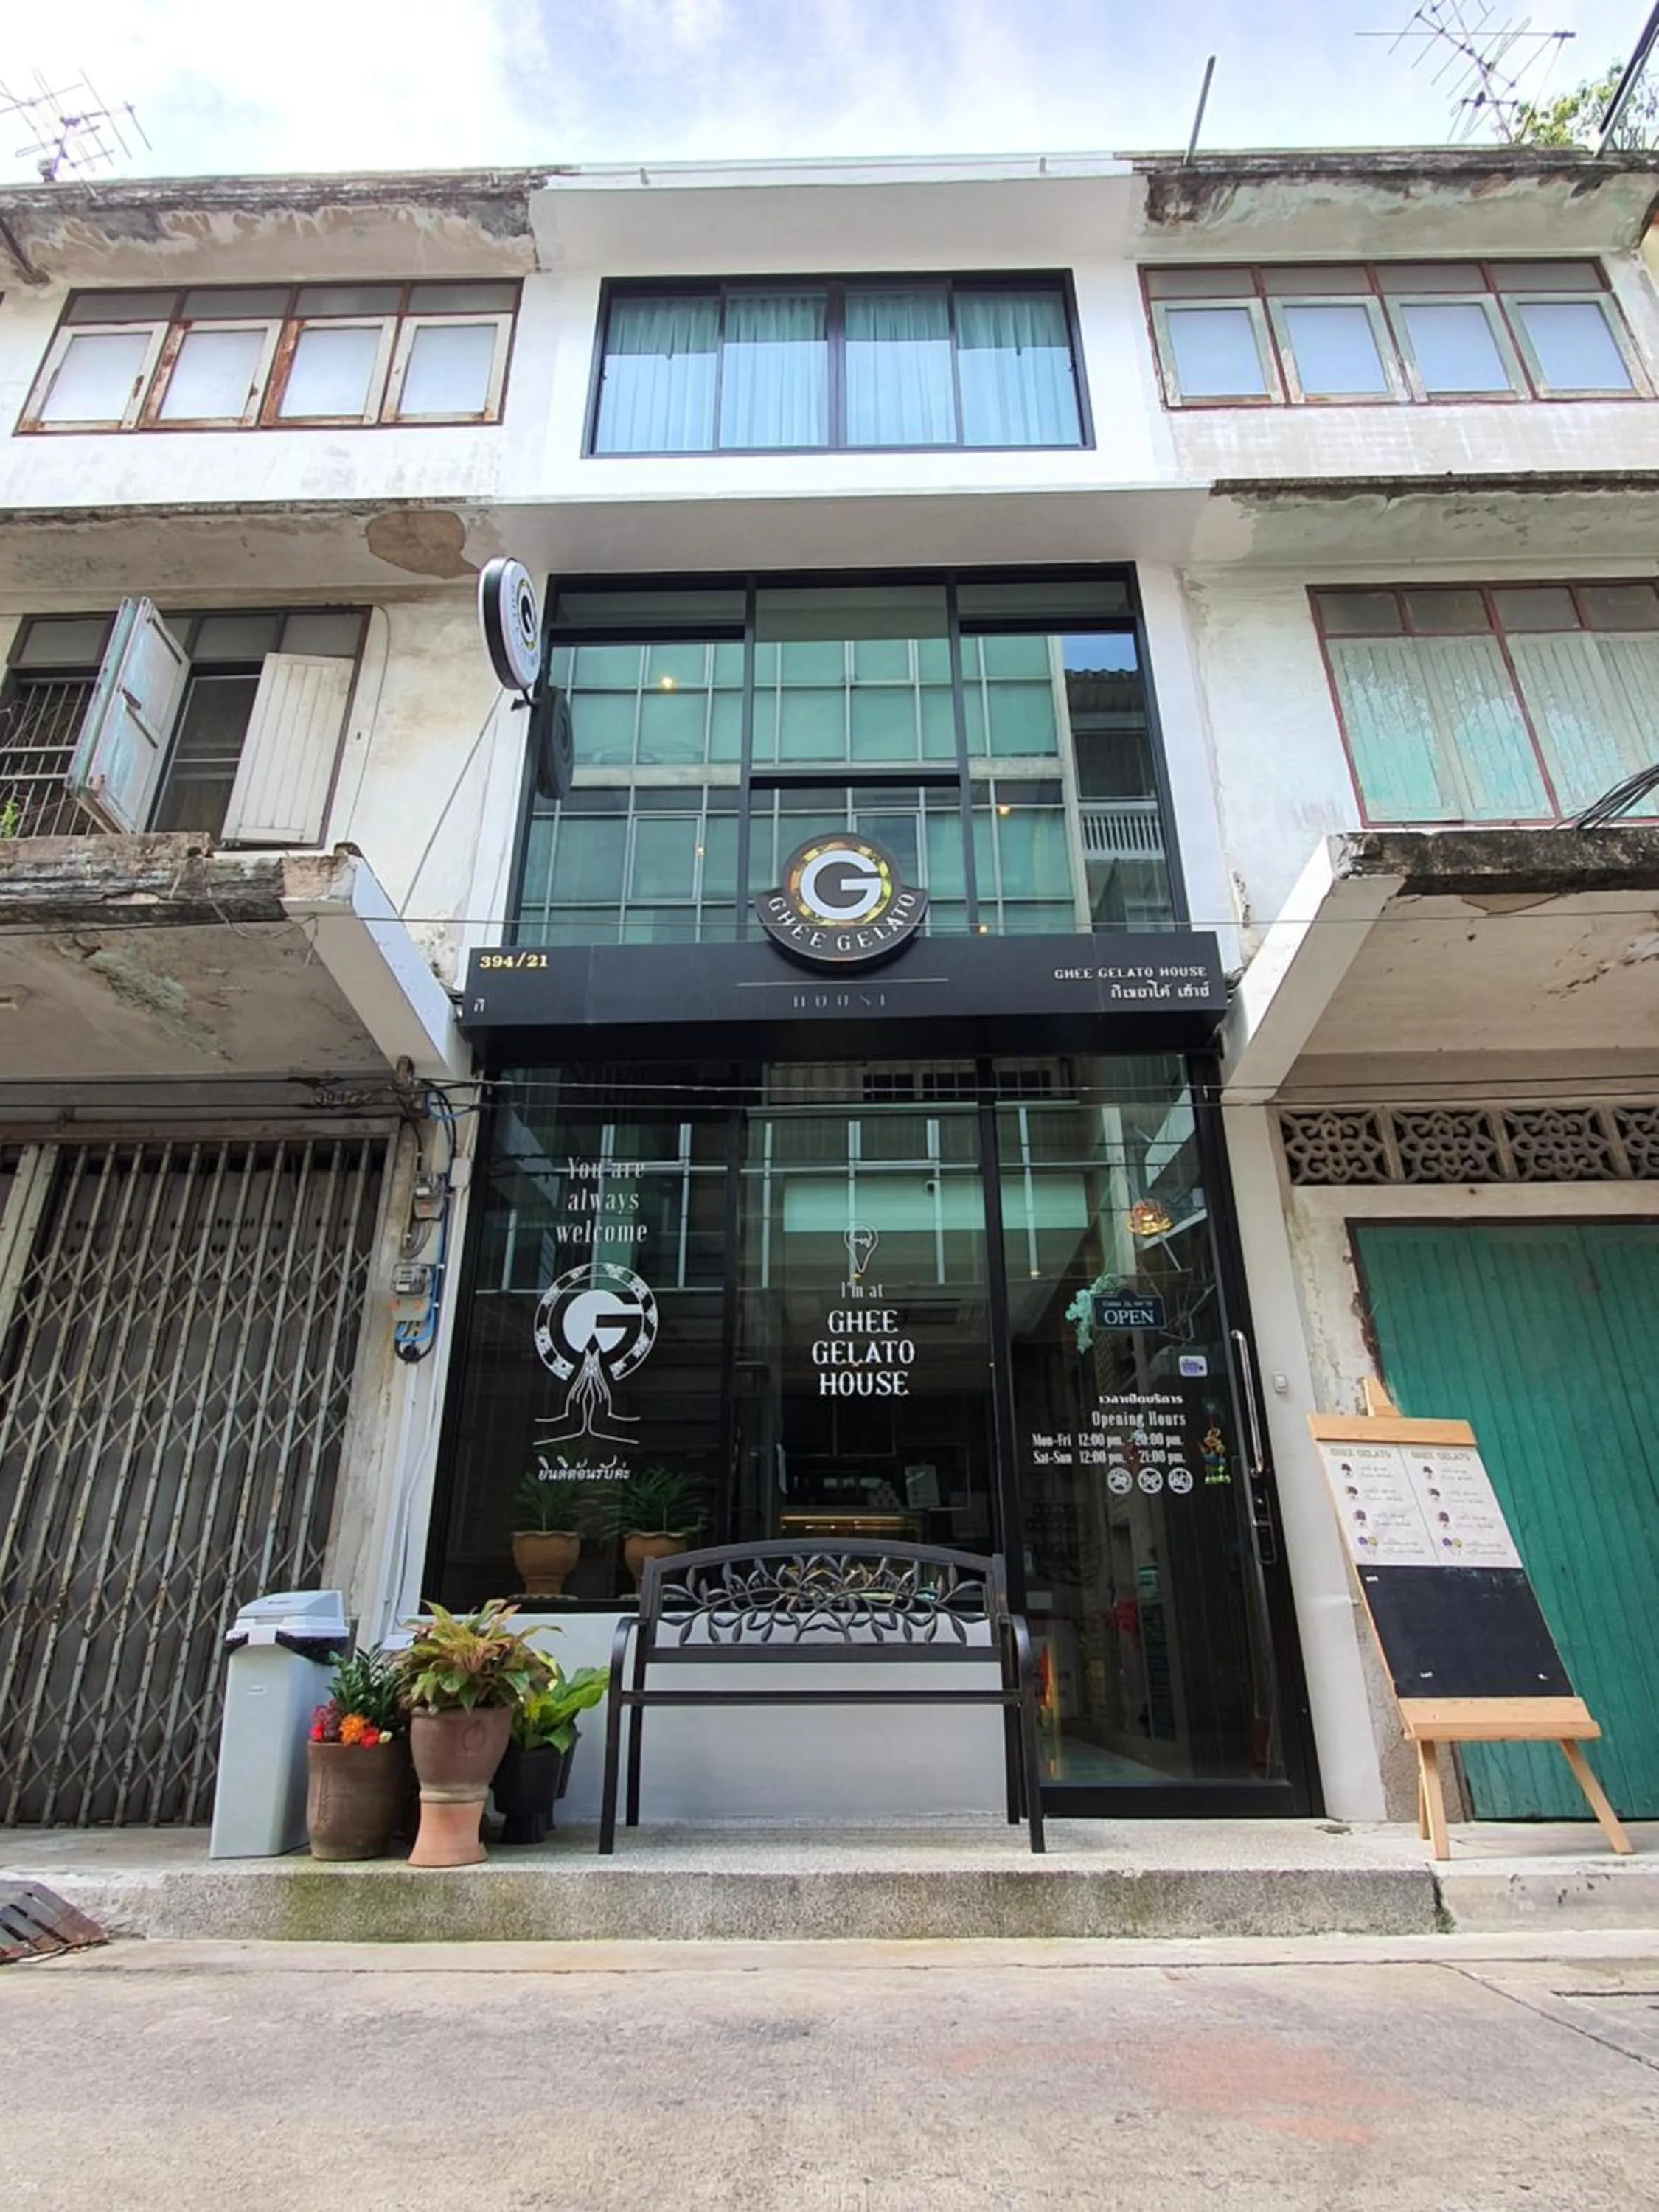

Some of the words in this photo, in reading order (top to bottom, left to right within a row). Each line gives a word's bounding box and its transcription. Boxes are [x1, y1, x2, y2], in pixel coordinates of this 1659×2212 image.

[800, 849, 883, 920] G
[768, 897, 827, 949] GHEE
[836, 893, 917, 952] GELATO
[479, 951, 548, 969] 394/21
[1054, 967, 1093, 979] GHEE
[1097, 967, 1154, 978] GELATO
[1160, 967, 1208, 978] HOUSE
[568, 1156, 603, 1180] You
[611, 1162, 645, 1179] are
[567, 1188, 640, 1215] always
[556, 1219, 648, 1243] welcome
[841, 1281, 864, 1298] I'm
[869, 1282, 883, 1298] at
[827, 1310, 899, 1334] GHEE
[1104, 1309, 1155, 1324] OPEN
[812, 1340, 915, 1365] GELATO
[820, 1371, 910, 1396] HOUSE
[1092, 1411, 1144, 1428] Opening
[1148, 1410, 1186, 1426] Hours
